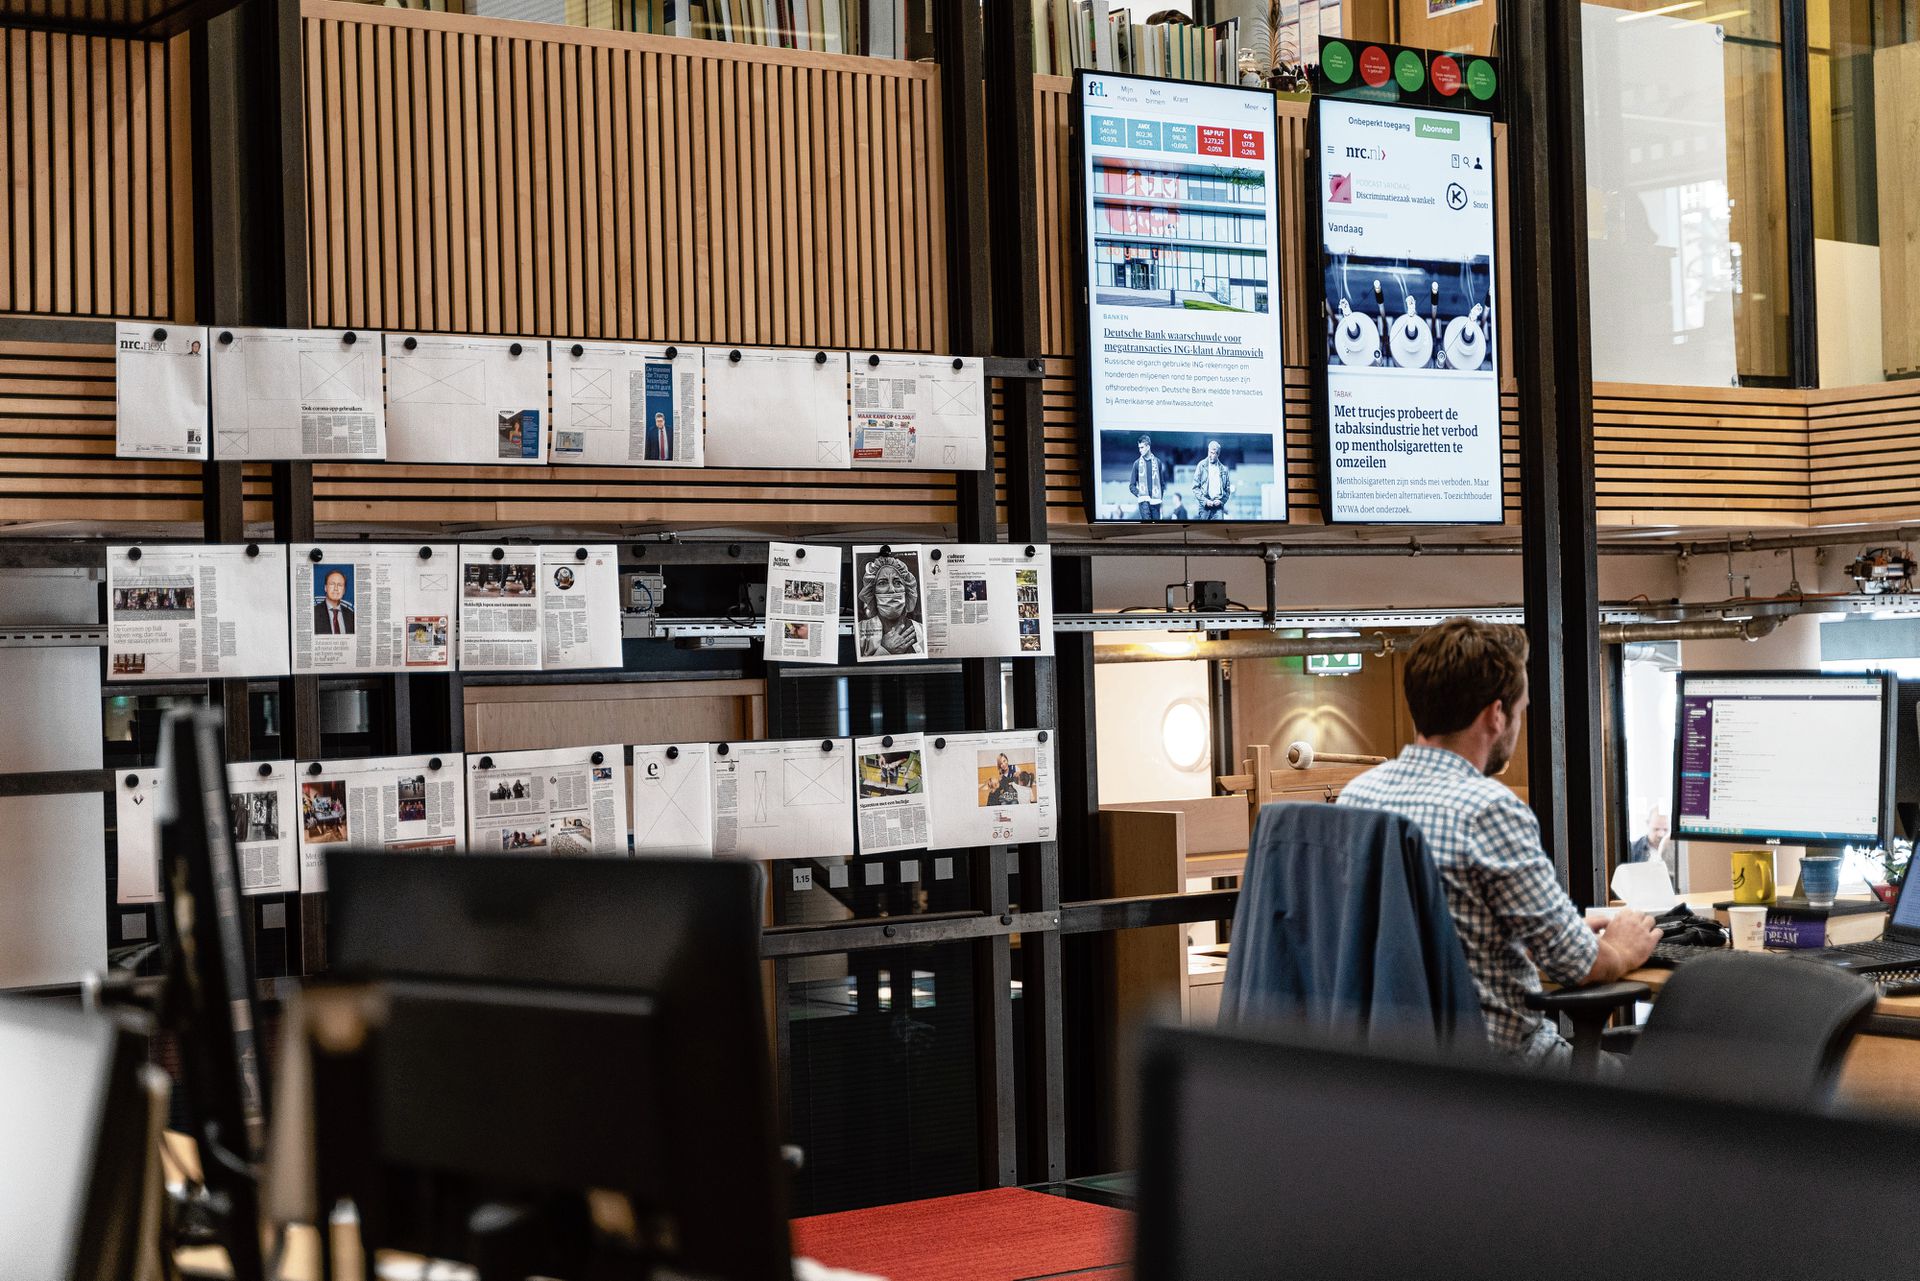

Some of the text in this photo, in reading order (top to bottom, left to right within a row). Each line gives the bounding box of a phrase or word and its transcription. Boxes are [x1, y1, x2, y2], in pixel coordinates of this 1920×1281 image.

[1088, 81, 1108, 97] fd.
[1121, 86, 1134, 94] Mijn
[1173, 96, 1188, 104] Krant
[1348, 116, 1410, 131] Onbeperkt toegang
[1422, 124, 1453, 134] Abonneer
[1356, 192, 1436, 205] Discriminatiezaak wankelt
[1328, 222, 1363, 236] Vandaag
[1104, 328, 1142, 338] Deutsche
[1145, 330, 1166, 339] Bank
[1168, 332, 1222, 342] waarschuwde
[1104, 343, 1264, 357] megatransacties ING-klant Abramovich
[1137, 359, 1161, 367] oligarch
[1162, 360, 1191, 368] gebruikte
[1140, 372, 1170, 380] miljoenen
[1241, 376, 1251, 384] zijn
[1105, 397, 1114, 405] bij
[1115, 397, 1154, 405] Amerikaanse
[1334, 405, 1458, 421] Met trucjes probeert de
[1335, 422, 1478, 437] tabaksindustrie het verbod
[1335, 439, 1463, 455] op mentholsigaretten te
[1336, 456, 1387, 468] omzeilen
[1337, 477, 1395, 487] Mentholsigaretten
[1397, 478, 1409, 487] zijn
[1410, 478, 1426, 486] sinds
[1428, 478, 1440, 486] mei
[1441, 478, 1472, 486] verboden.
[1337, 490, 1492, 500] fabrikanten bieden alternatieven. Toezichthouder
[1360, 505, 1375, 513] doet
[1376, 505, 1412, 513] onderzoek.
[795, 875, 810, 883] 1.15
